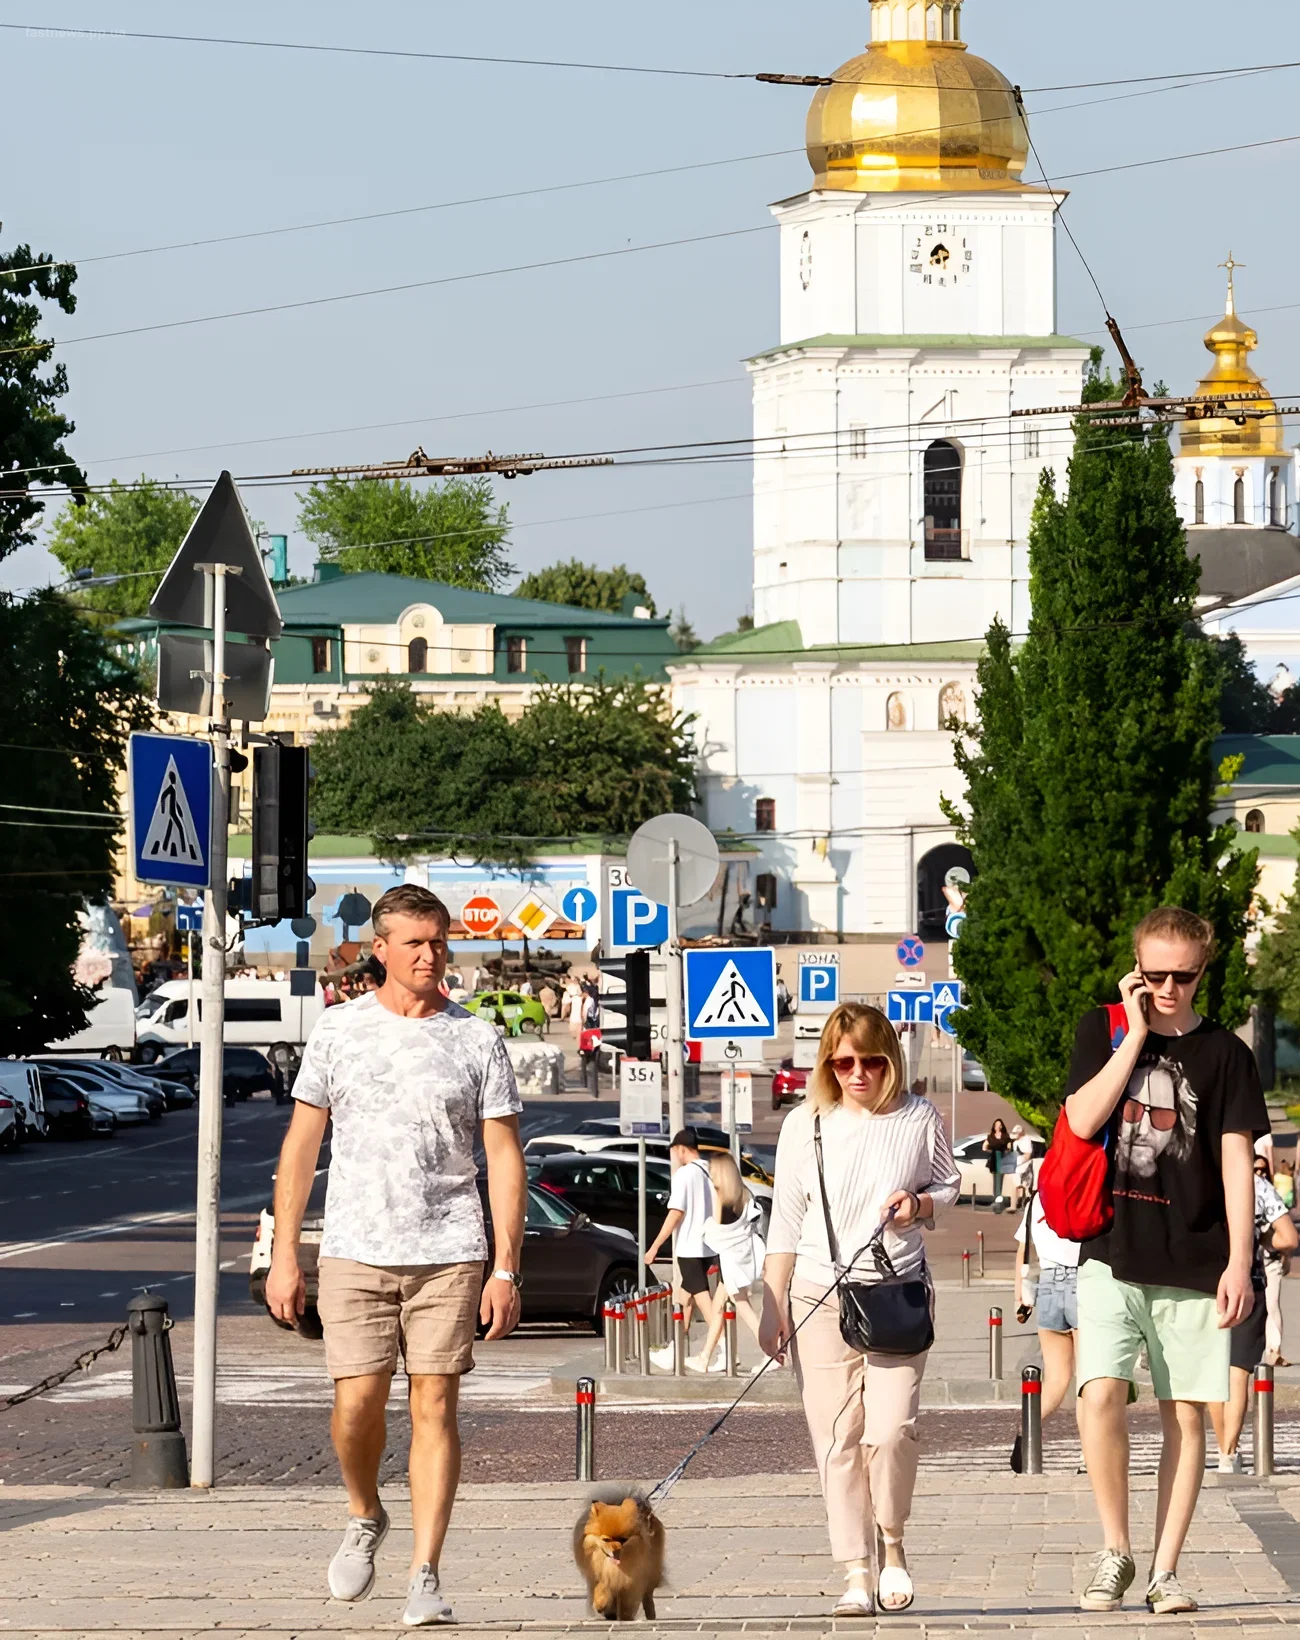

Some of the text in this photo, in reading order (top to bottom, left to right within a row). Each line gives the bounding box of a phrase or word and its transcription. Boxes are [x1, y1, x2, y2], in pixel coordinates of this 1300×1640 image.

[464, 907, 500, 923] STOP
[626, 895, 658, 943] P
[809, 969, 830, 1001] P
